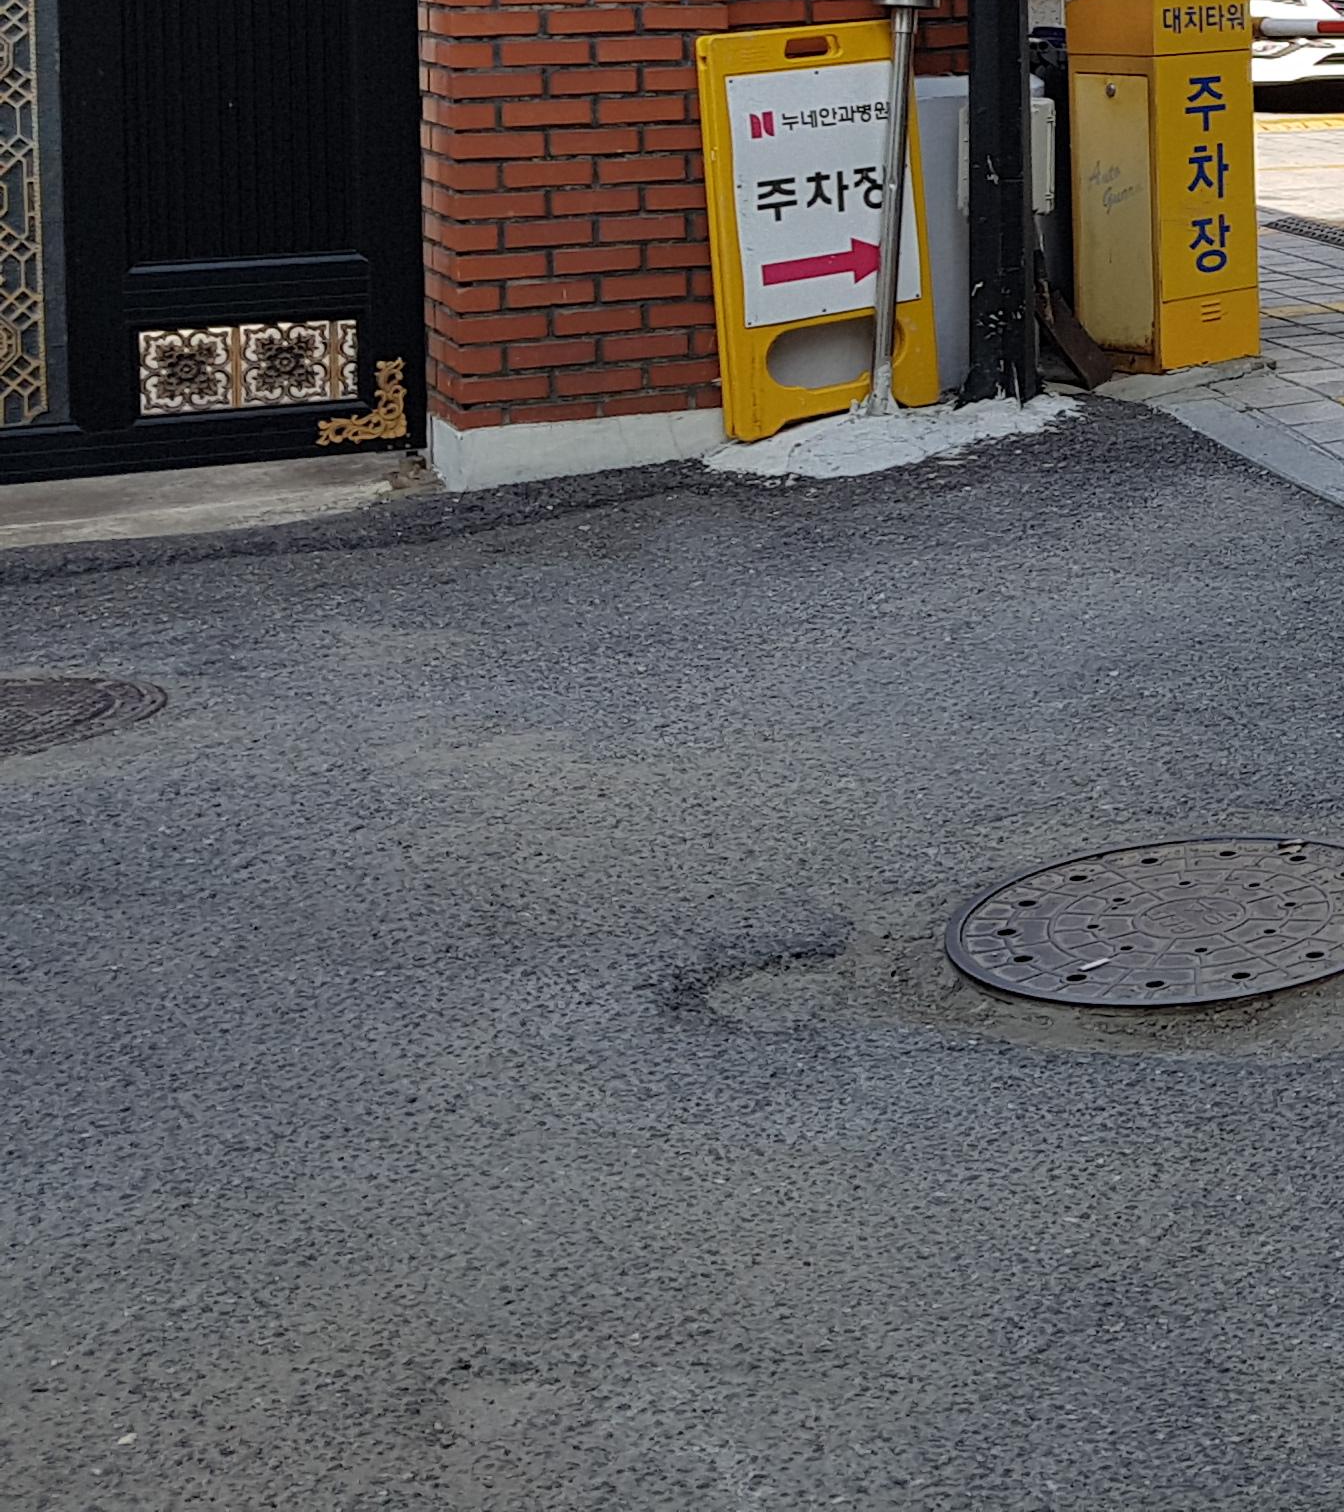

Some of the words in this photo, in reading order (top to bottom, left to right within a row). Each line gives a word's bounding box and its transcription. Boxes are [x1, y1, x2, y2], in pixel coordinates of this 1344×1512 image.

[1163, 4, 1245, 34] 대치타워
[781, 101, 890, 131] 누네안과병원
[1185, 75, 1231, 274] 주차장
